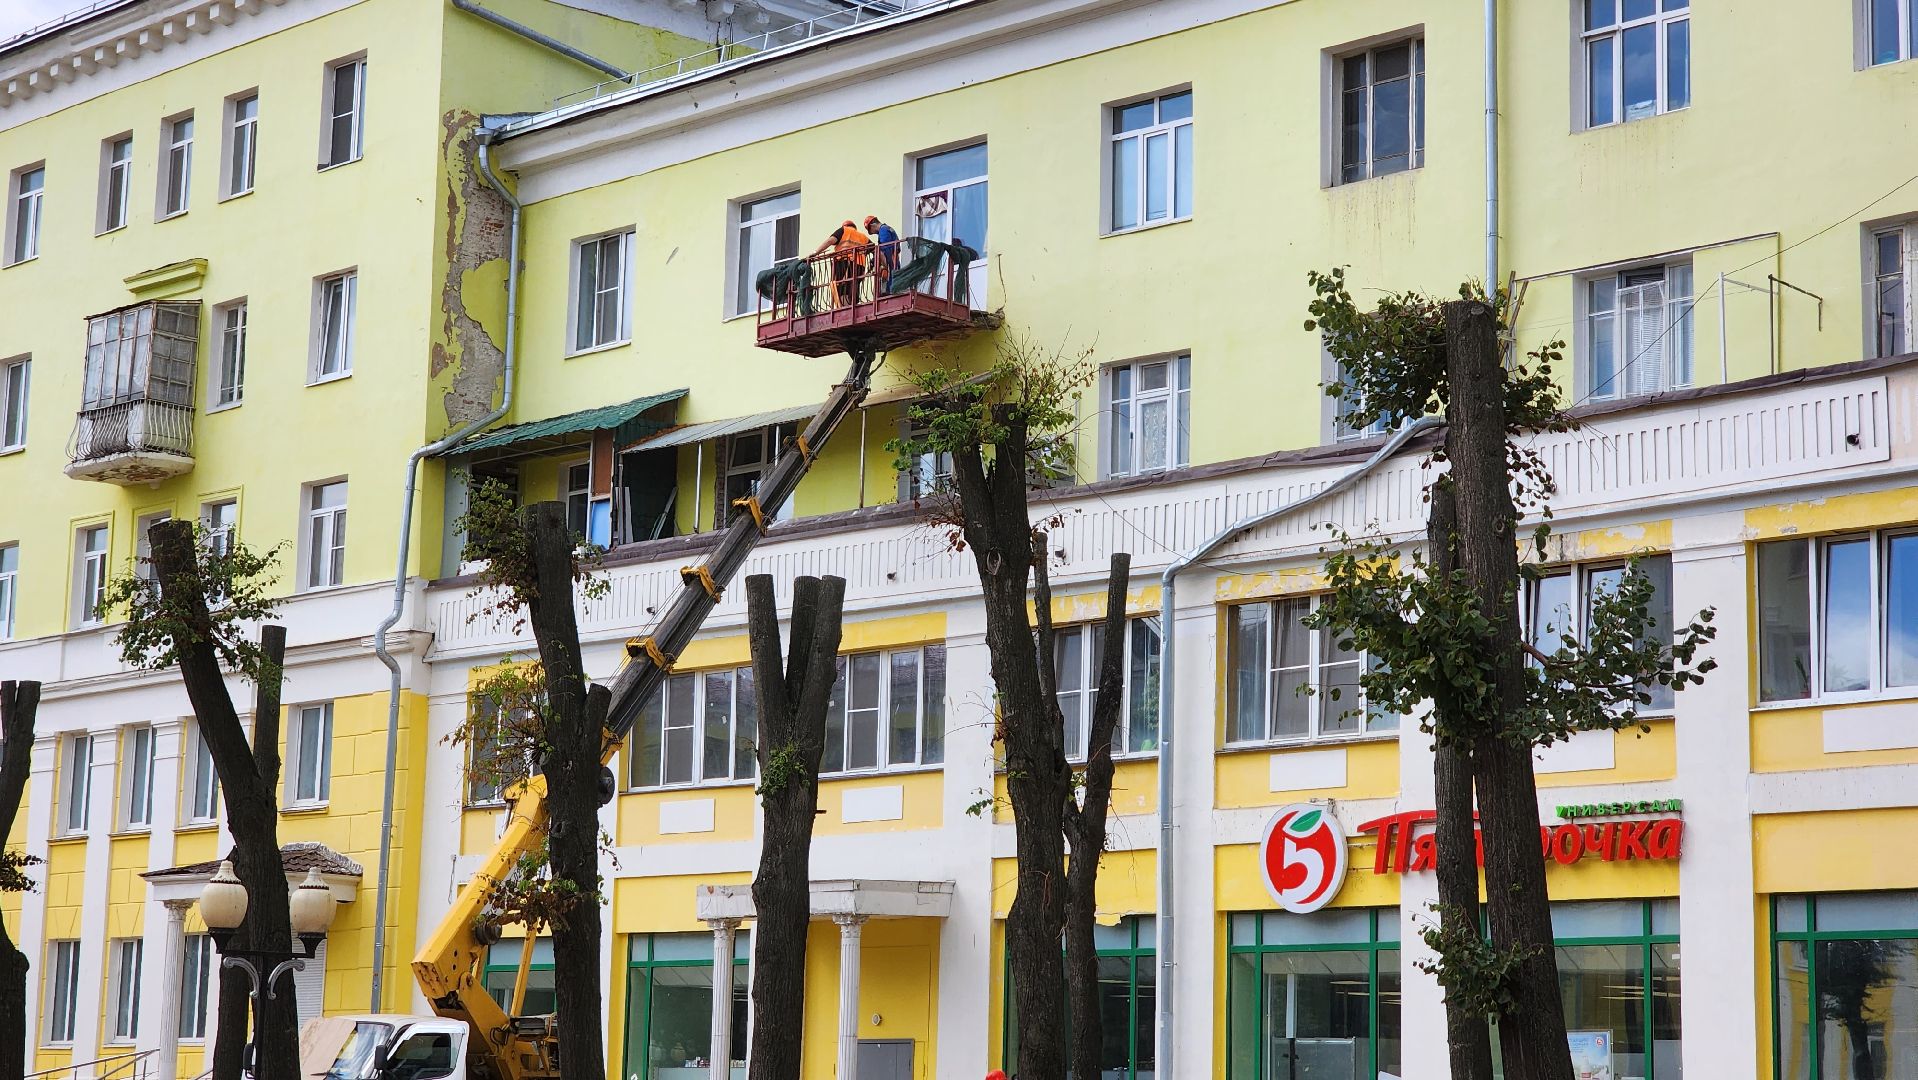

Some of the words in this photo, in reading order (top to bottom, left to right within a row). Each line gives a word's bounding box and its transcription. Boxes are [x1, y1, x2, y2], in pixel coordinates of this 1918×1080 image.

[1555, 799, 1683, 818] УНИВЕРСАМ
[1281, 812, 1326, 904] 5
[1357, 809, 1684, 875] Пяочка
